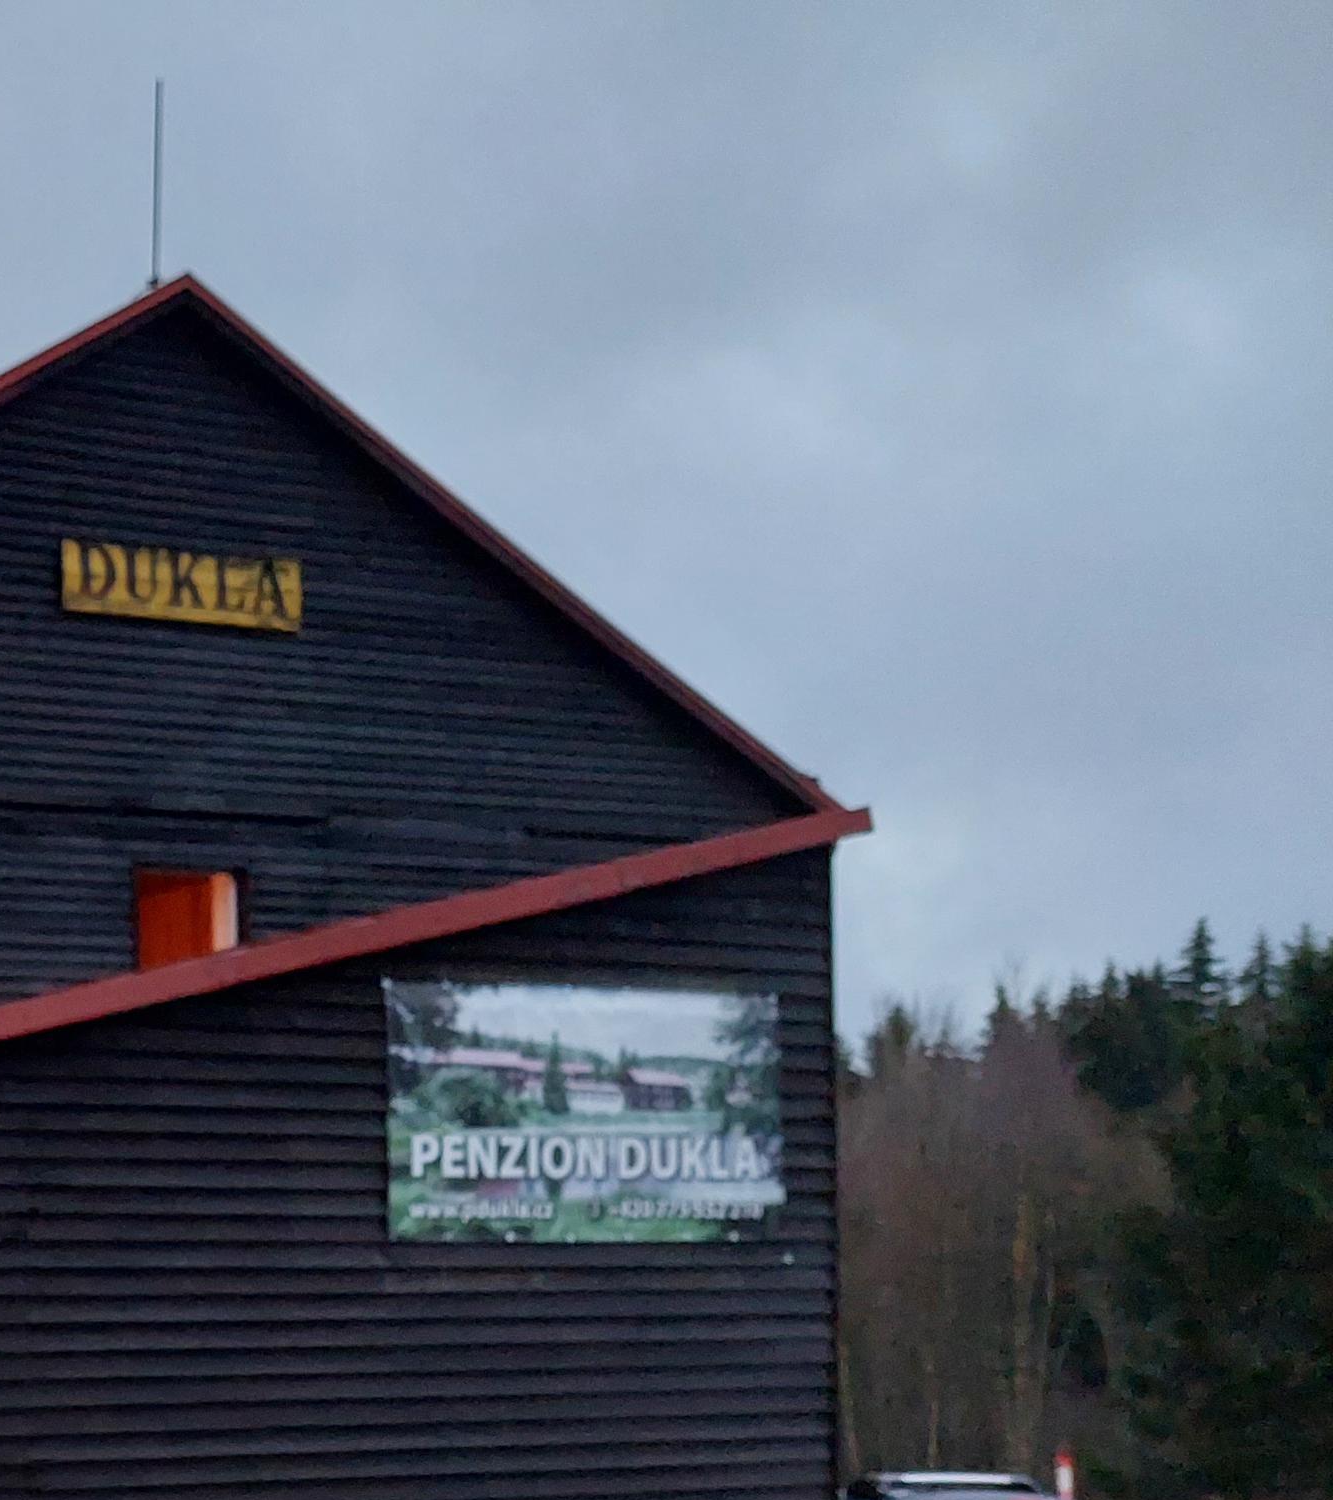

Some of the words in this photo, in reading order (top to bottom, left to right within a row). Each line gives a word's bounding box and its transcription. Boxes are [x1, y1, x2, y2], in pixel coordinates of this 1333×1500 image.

[80, 546, 290, 618] DUKLA
[410, 1134, 606, 1179] PENZION
[620, 1134, 761, 1181] DUKLA
